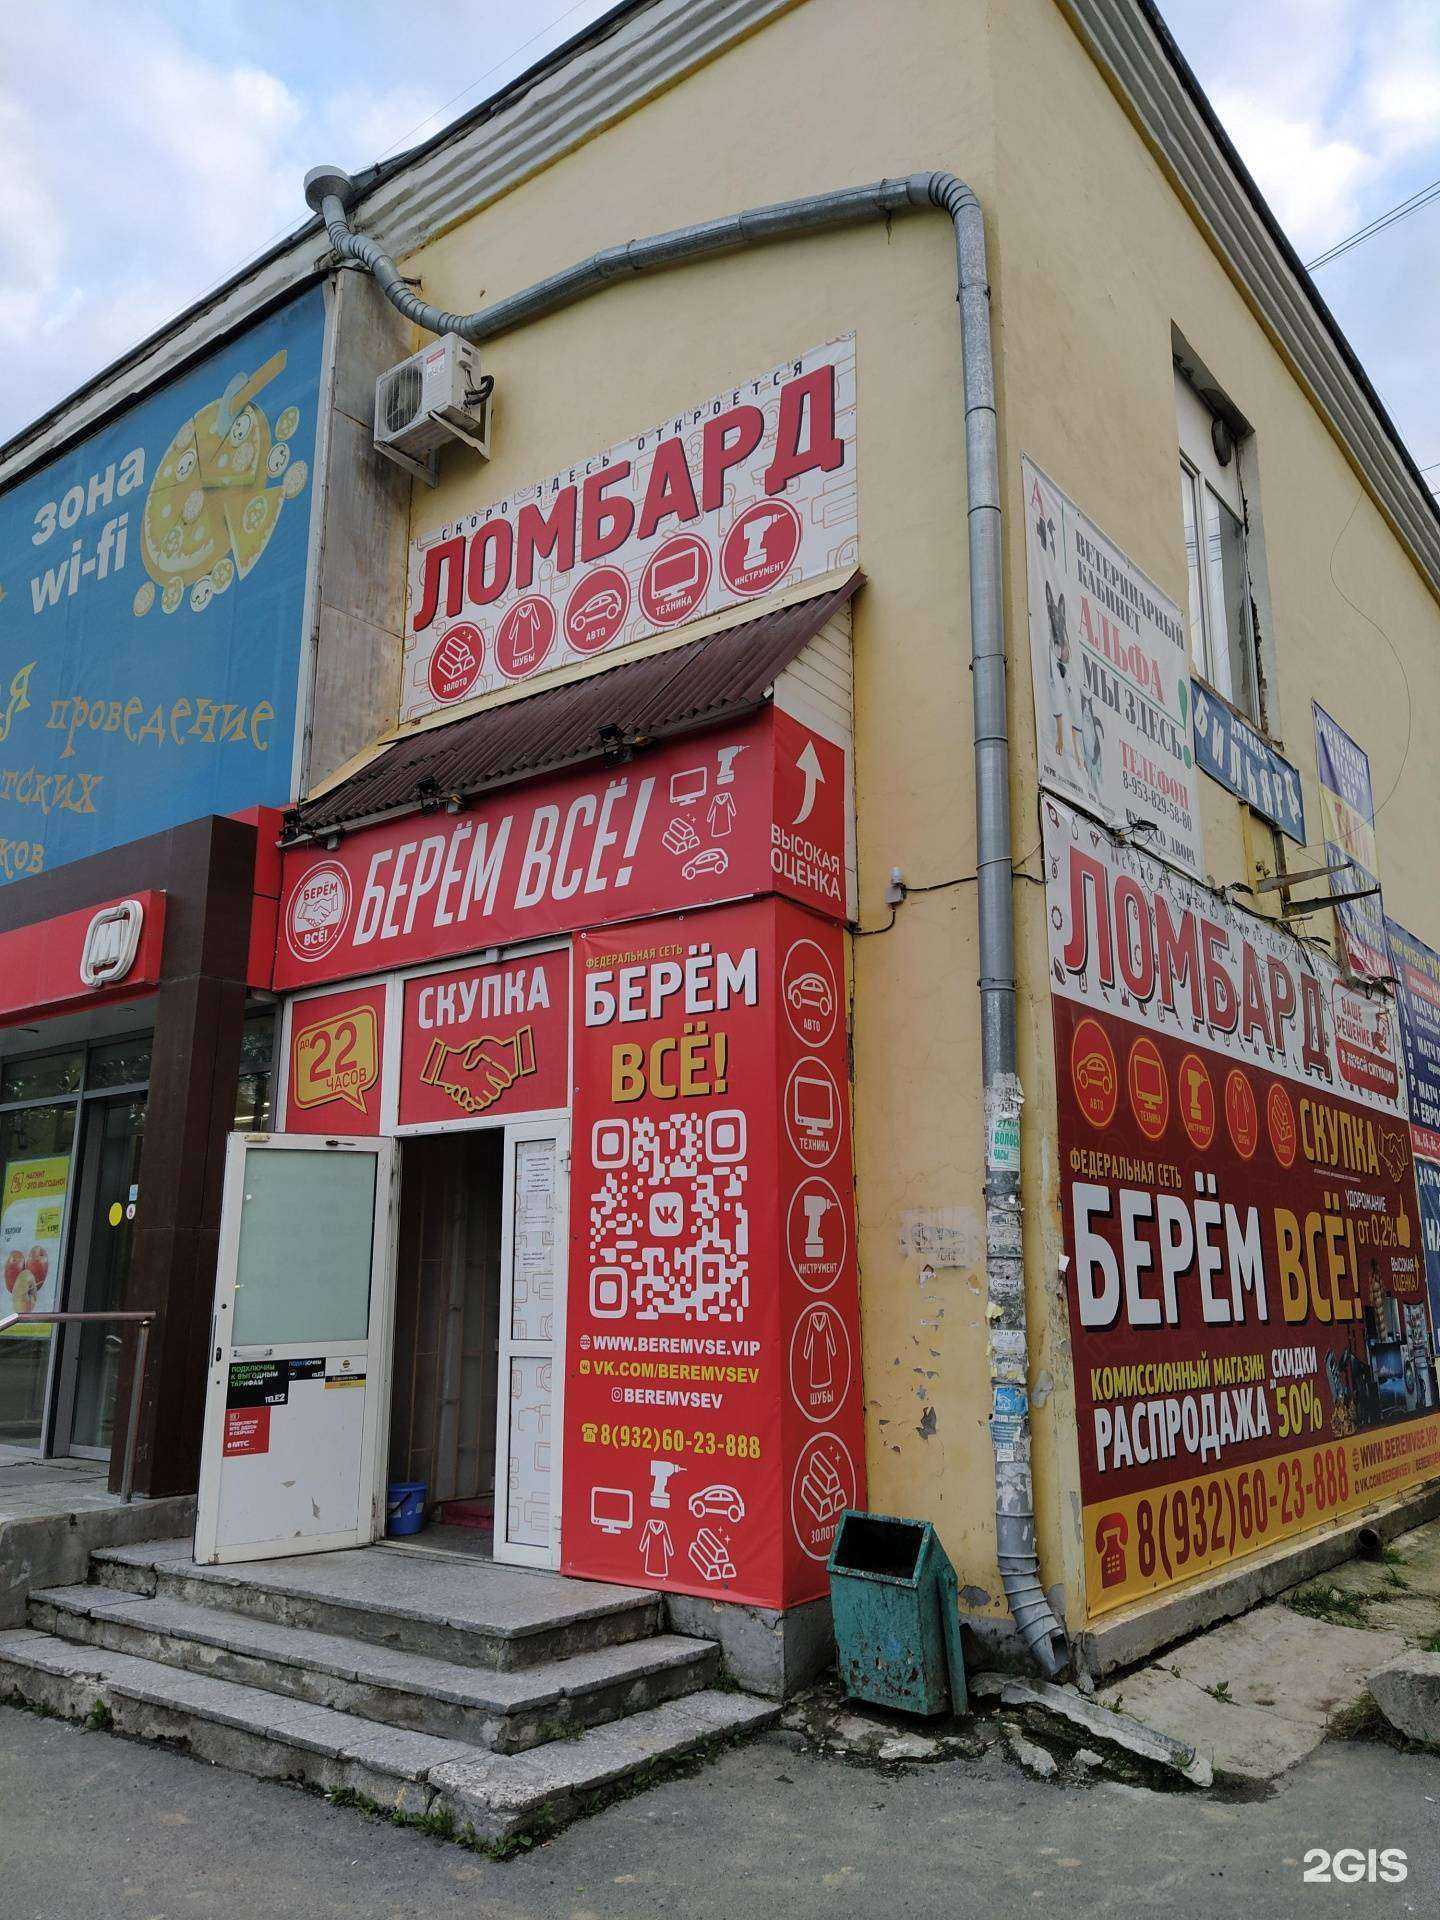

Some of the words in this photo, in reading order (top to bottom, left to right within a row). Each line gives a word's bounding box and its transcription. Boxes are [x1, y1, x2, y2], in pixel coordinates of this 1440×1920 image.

[441, 503, 509, 541] СКОРО
[536, 456, 611, 499] ЗДЕСЬ
[637, 361, 803, 451] ОТКРОЕТСЯ
[412, 364, 845, 632] ЛОМБАРД
[30, 513, 128, 614] wi-fi
[734, 560, 786, 586] ИНСТРУМЕНТ
[655, 595, 694, 616] ТЕХНИКА
[1075, 529, 1185, 652] ВЕТЕРИНАРНЫЙ
[1077, 559, 1142, 636] КАБИНЕТ
[512, 652, 536, 668] ШУБЫ
[585, 626, 607, 643] АВТО
[1078, 596, 1166, 705] АЛЬФА
[442, 675, 469, 694] ЗОЛОТО
[1119, 737, 1189, 810] ТЕЛЕФОН
[1122, 770, 1192, 832] 8-953-829-58-80
[352, 815, 515, 946] БЕРЁМ
[514, 776, 657, 911] ВСЁ!
[770, 823, 841, 875] ВЫСОКАЯ
[770, 848, 842, 902] ОЦЕНКА
[303, 881, 338, 901] БЕРЁМ
[585, 946, 657, 969] ФЕДЕРАЛЬНАЯ
[660, 944, 684, 958] СЕТЬ
[1063, 845, 1333, 1084] ЛОМБАРД
[417, 966, 551, 1030] СКУПКА
[584, 943, 758, 1028] БЕРЁМ
[309, 1021, 357, 1082] 22
[803, 1019, 821, 1033] АВТО
[326, 1067, 367, 1091] ЧАСОВ
[611, 1021, 728, 1102] ВСЁ!
[799, 1136, 830, 1153] ТЕХНИКА
[1300, 1099, 1381, 1176] СКУПКА
[1069, 1147, 1154, 1184] ФЕДЕРАЛЬНАЯ
[1157, 1163, 1183, 1189] СЕТЬ
[799, 1262, 838, 1274] ИНСТРУМЕНТ
[1071, 1171, 1268, 1327] БЕРЁМ
[1274, 1192, 1364, 1322] ВСЁ!
[593, 1335, 761, 1357] WWW.BEREMVSE.VIP
[593, 1360, 760, 1383] VK.COM/BEREMVSEV
[1271, 1346, 1318, 1379] СКИДКИ
[624, 1387, 723, 1410] BEREMVSEV
[810, 1390, 834, 1406] ШУБЫ
[1090, 1351, 1210, 1400] КОМИССИОННЫЙ
[1213, 1354, 1266, 1388] МАГАЗИН
[1093, 1386, 1272, 1472] РАСПРОДАЖА
[1276, 1379, 1323, 1438] 50%
[600, 1425, 761, 1460] 8(932)60-23-888
[1136, 1446, 1350, 1580] 8(932)60-23-888
